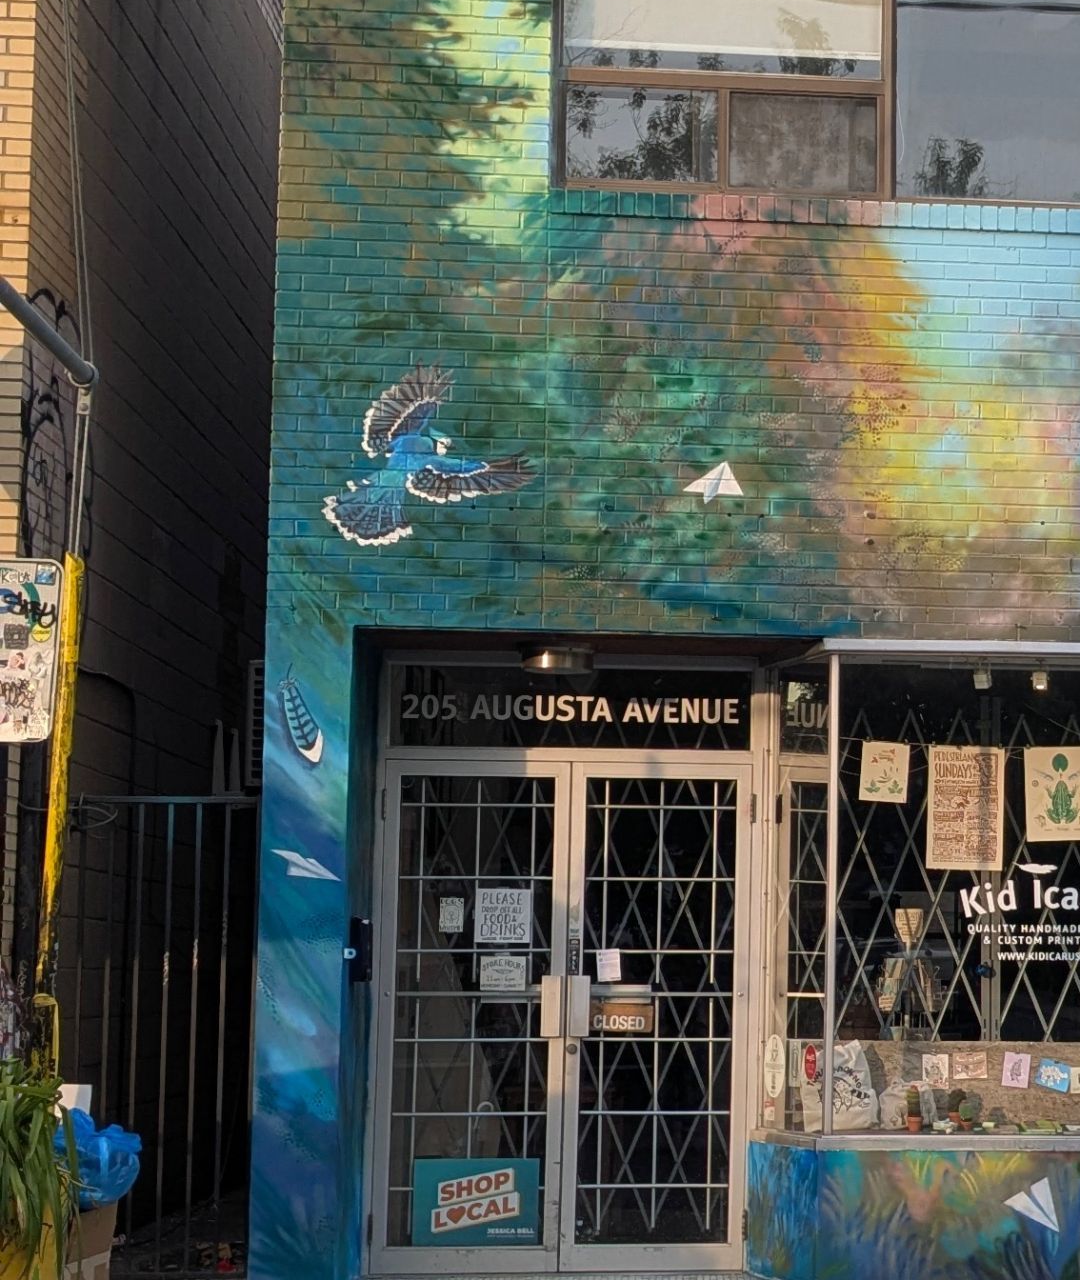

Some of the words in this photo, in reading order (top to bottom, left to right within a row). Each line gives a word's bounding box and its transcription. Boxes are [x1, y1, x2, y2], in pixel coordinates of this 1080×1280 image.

[402, 694, 457, 720] 205
[470, 694, 613, 723] AUGUSTA
[622, 697, 740, 725] AVENUE
[934, 762, 972, 778] SUNDAYS
[482, 892, 523, 905] PLEASE
[959, 879, 1018, 919] Kid
[484, 913, 511, 924] FOOD
[480, 922, 526, 937] DRINKS
[967, 924, 1017, 934] QUALITY
[983, 936, 991, 945] &
[997, 936, 1043, 945] CUSTOM
[1047, 936, 1080, 945] PRINT
[593, 1014, 646, 1030] CLOSED
[440, 1172, 510, 1202] SHOP
